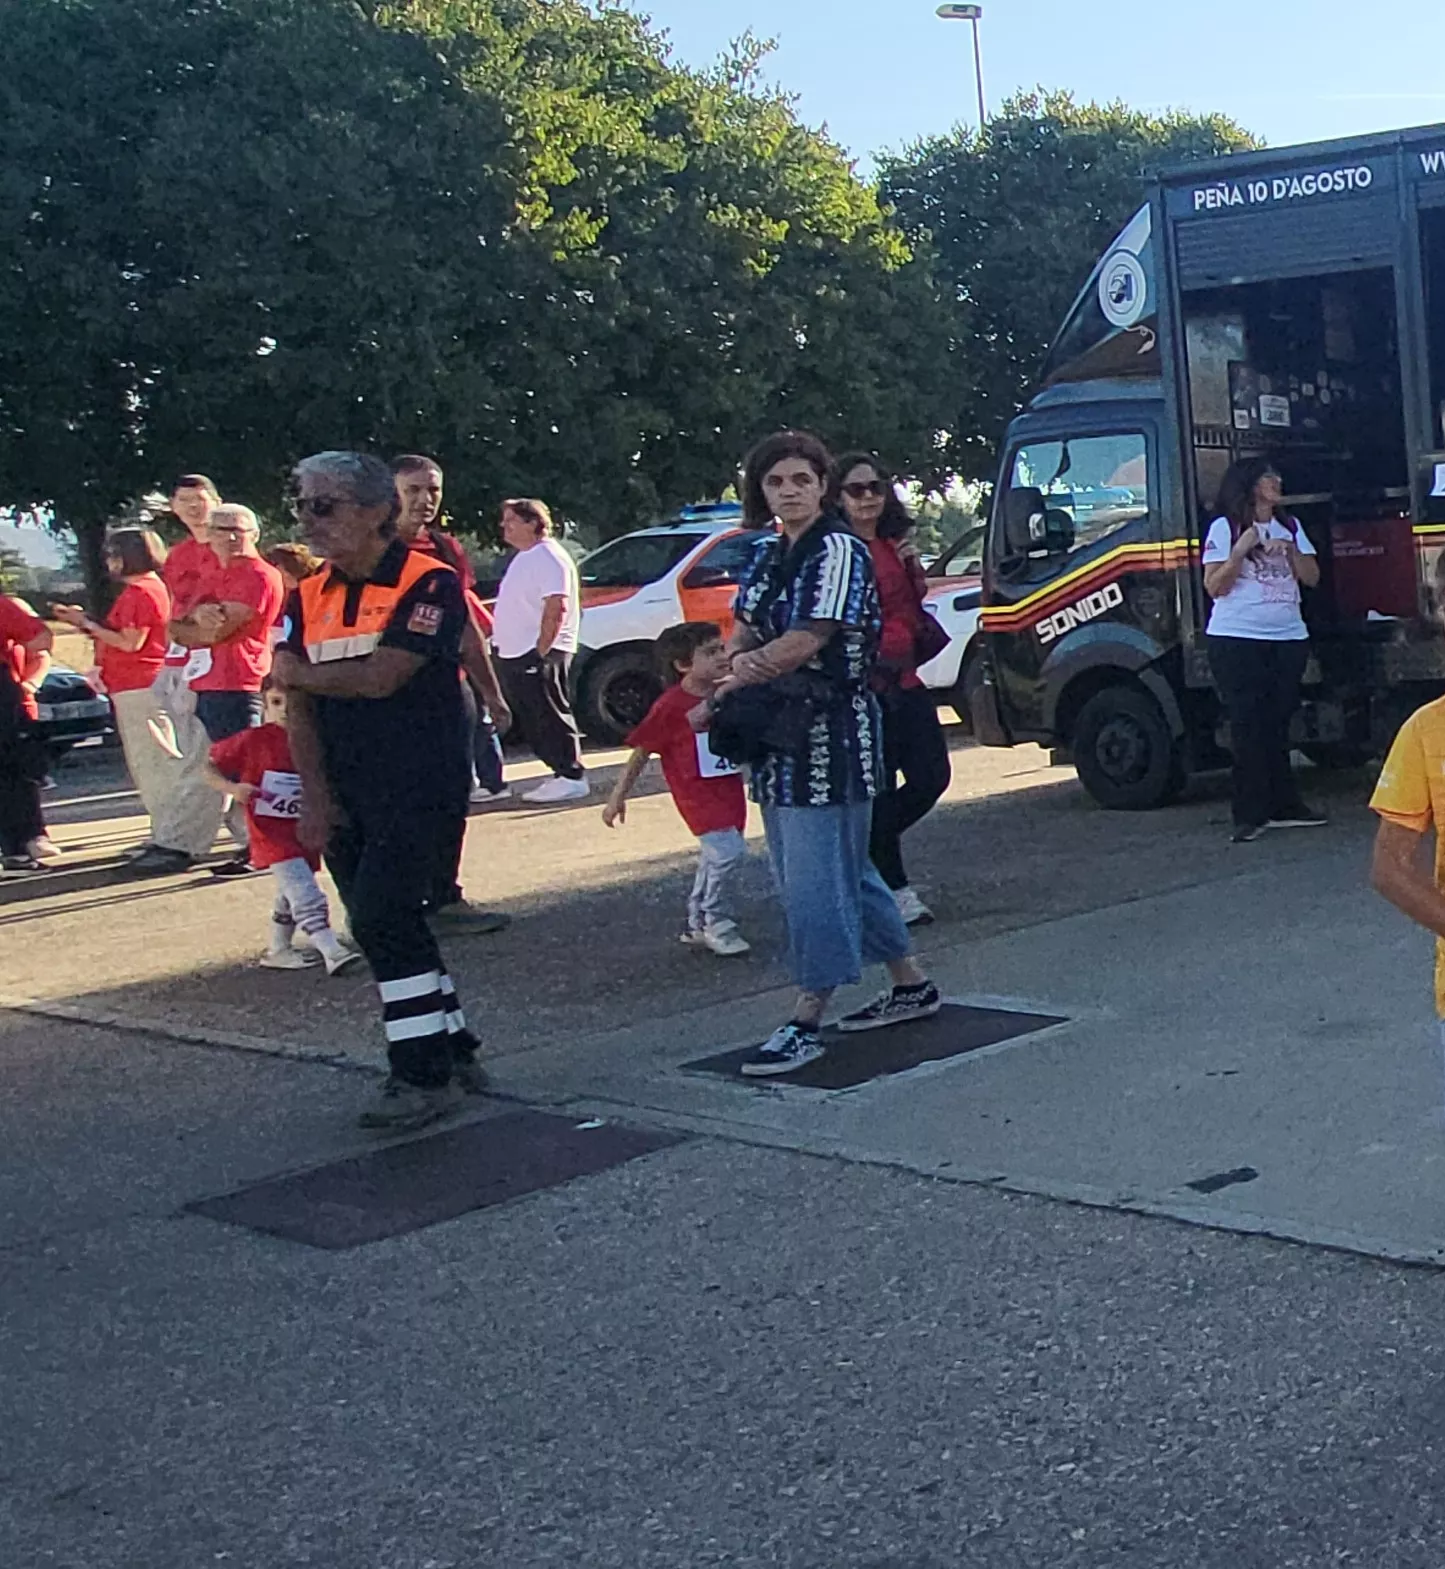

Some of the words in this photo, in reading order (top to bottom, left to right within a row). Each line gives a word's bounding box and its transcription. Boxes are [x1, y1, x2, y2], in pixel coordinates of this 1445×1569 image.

[1193, 182, 1245, 211] PEÑA
[1247, 181, 1268, 203] 10
[1272, 166, 1373, 201] D'AGOSTO
[1034, 582, 1125, 645] SONIDO
